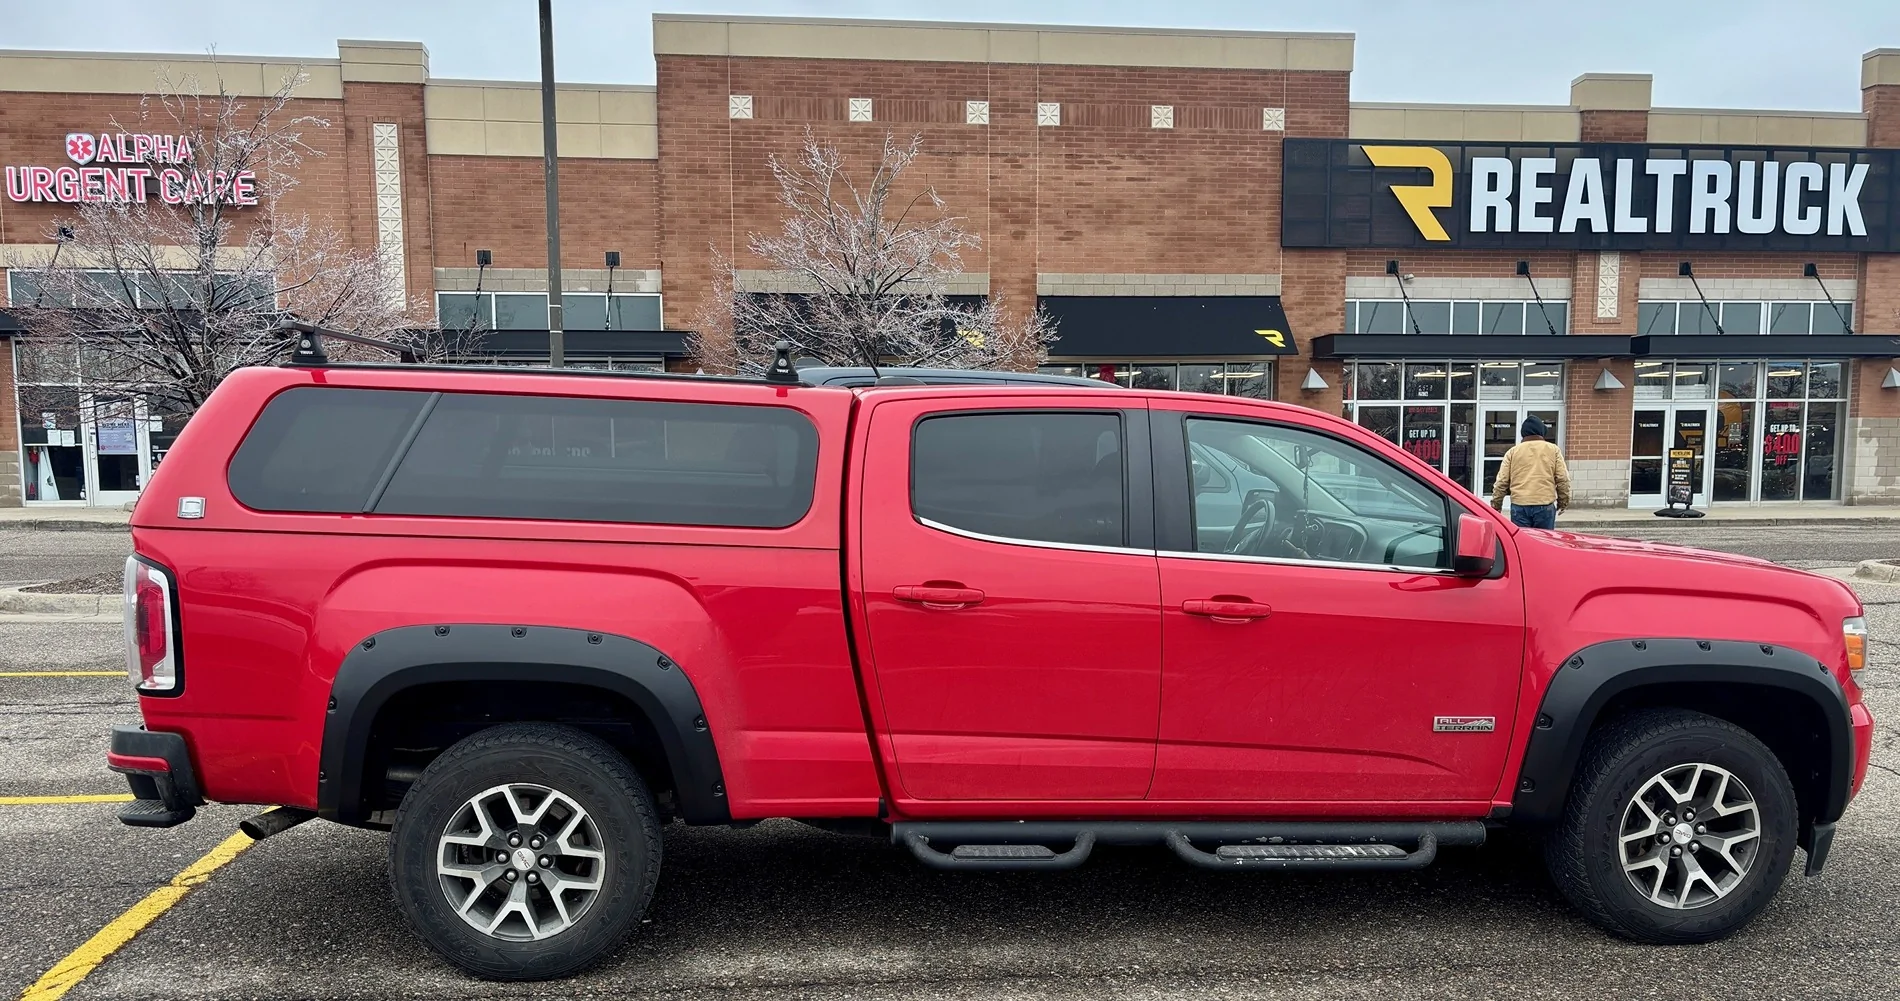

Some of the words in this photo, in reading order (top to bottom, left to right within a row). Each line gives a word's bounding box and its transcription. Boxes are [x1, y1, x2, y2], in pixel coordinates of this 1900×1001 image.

[96, 133, 195, 164] ALPHA
[5, 166, 151, 202] URGENT
[159, 168, 258, 205] CARE
[1469, 156, 1871, 236] REALTRUCK
[1409, 430, 1420, 439] GET
[1420, 430, 1429, 438] UP
[1429, 429, 1437, 438] TO
[1770, 424, 1780, 433] GET
[1781, 424, 1789, 433] UP
[1404, 439, 1441, 461] $400
[1764, 433, 1800, 455] $400
[1775, 454, 1788, 465] OFF
[516, 850, 531, 869] GMC
